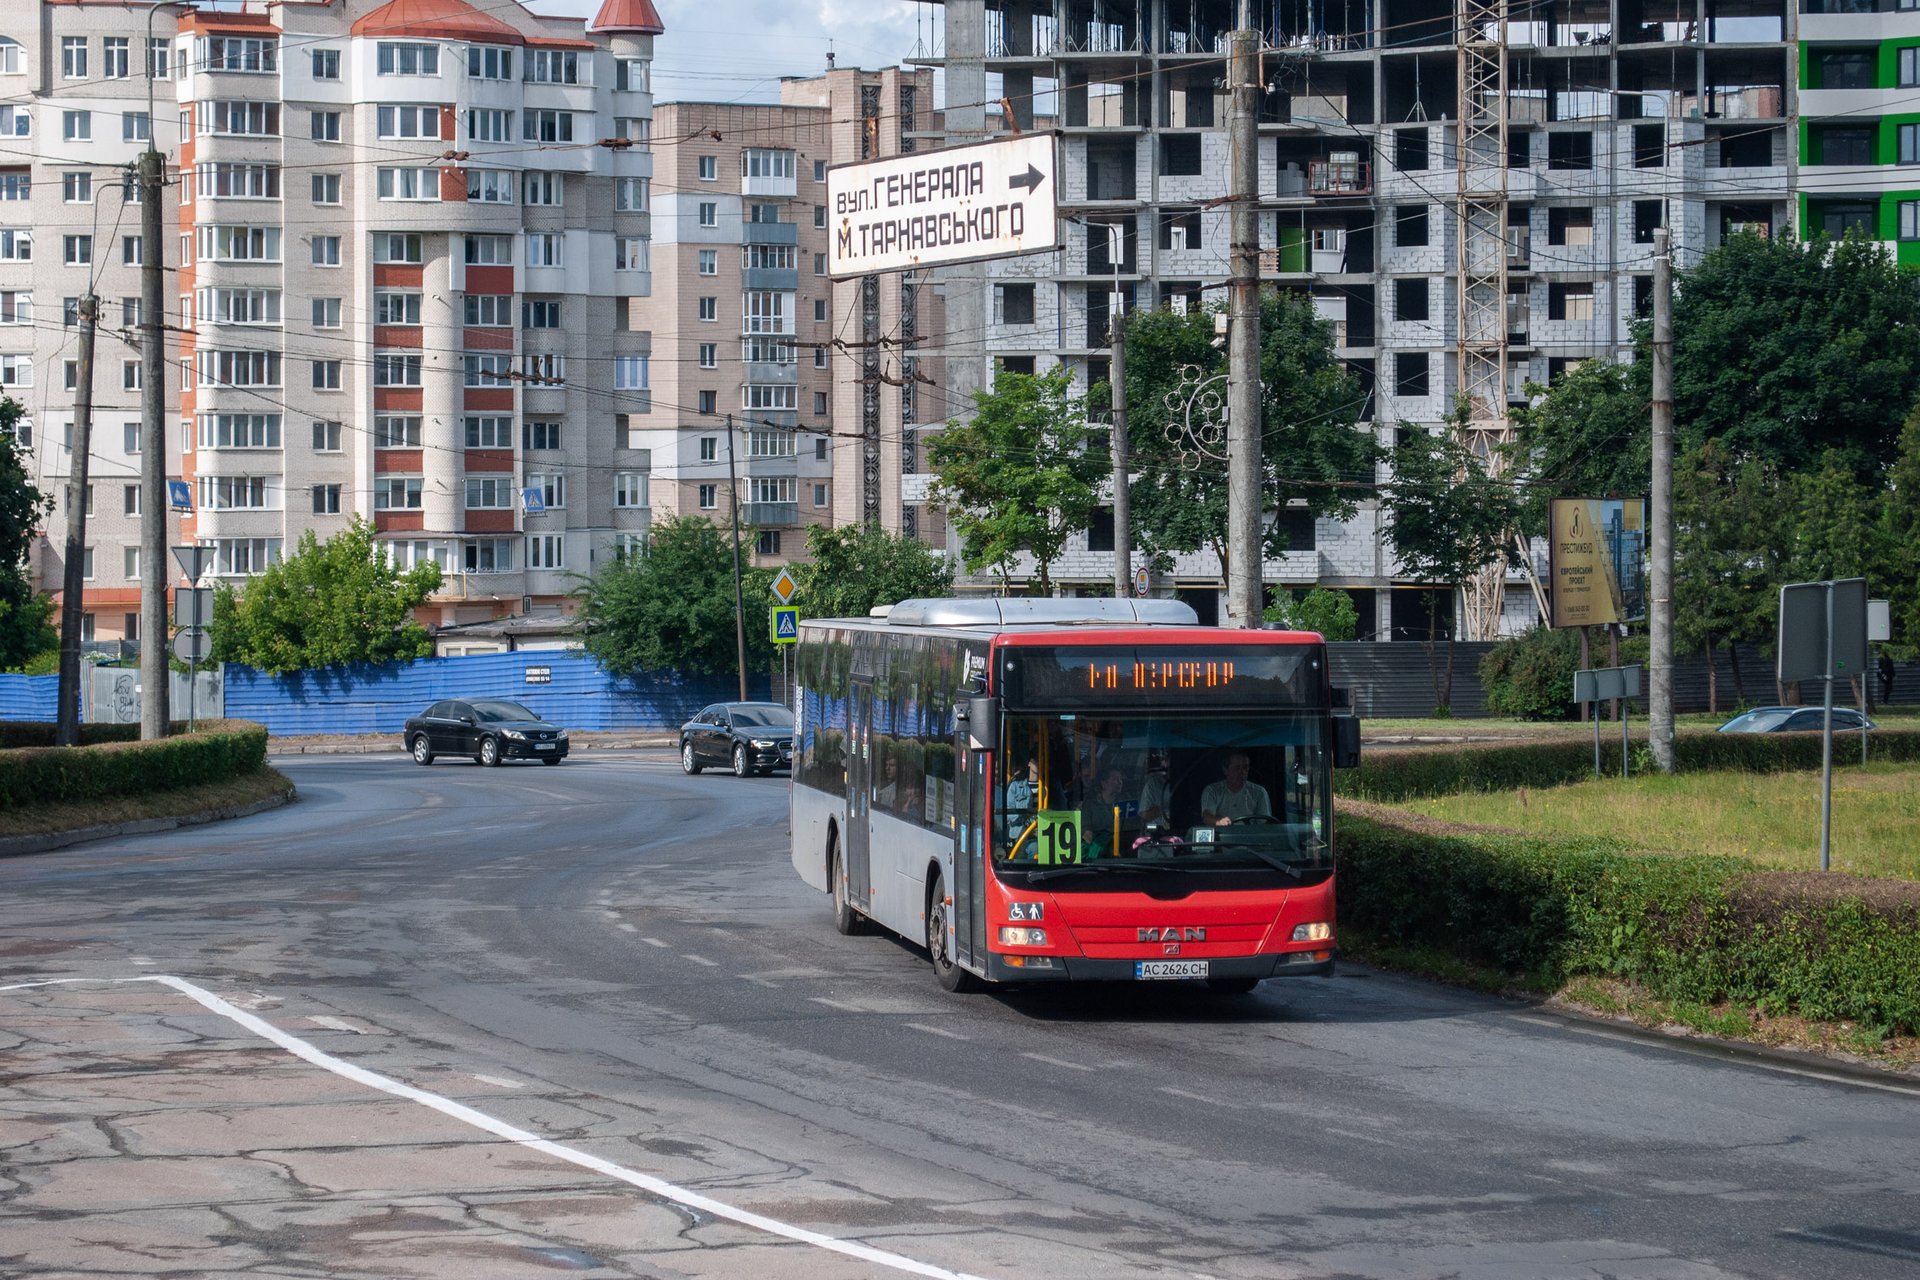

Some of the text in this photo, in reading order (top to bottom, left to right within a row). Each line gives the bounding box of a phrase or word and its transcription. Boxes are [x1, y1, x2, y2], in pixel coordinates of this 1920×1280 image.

[1042, 821, 1077, 865] 19
[1137, 927, 1206, 942] MAN
[1162, 964, 1189, 975] 2626
